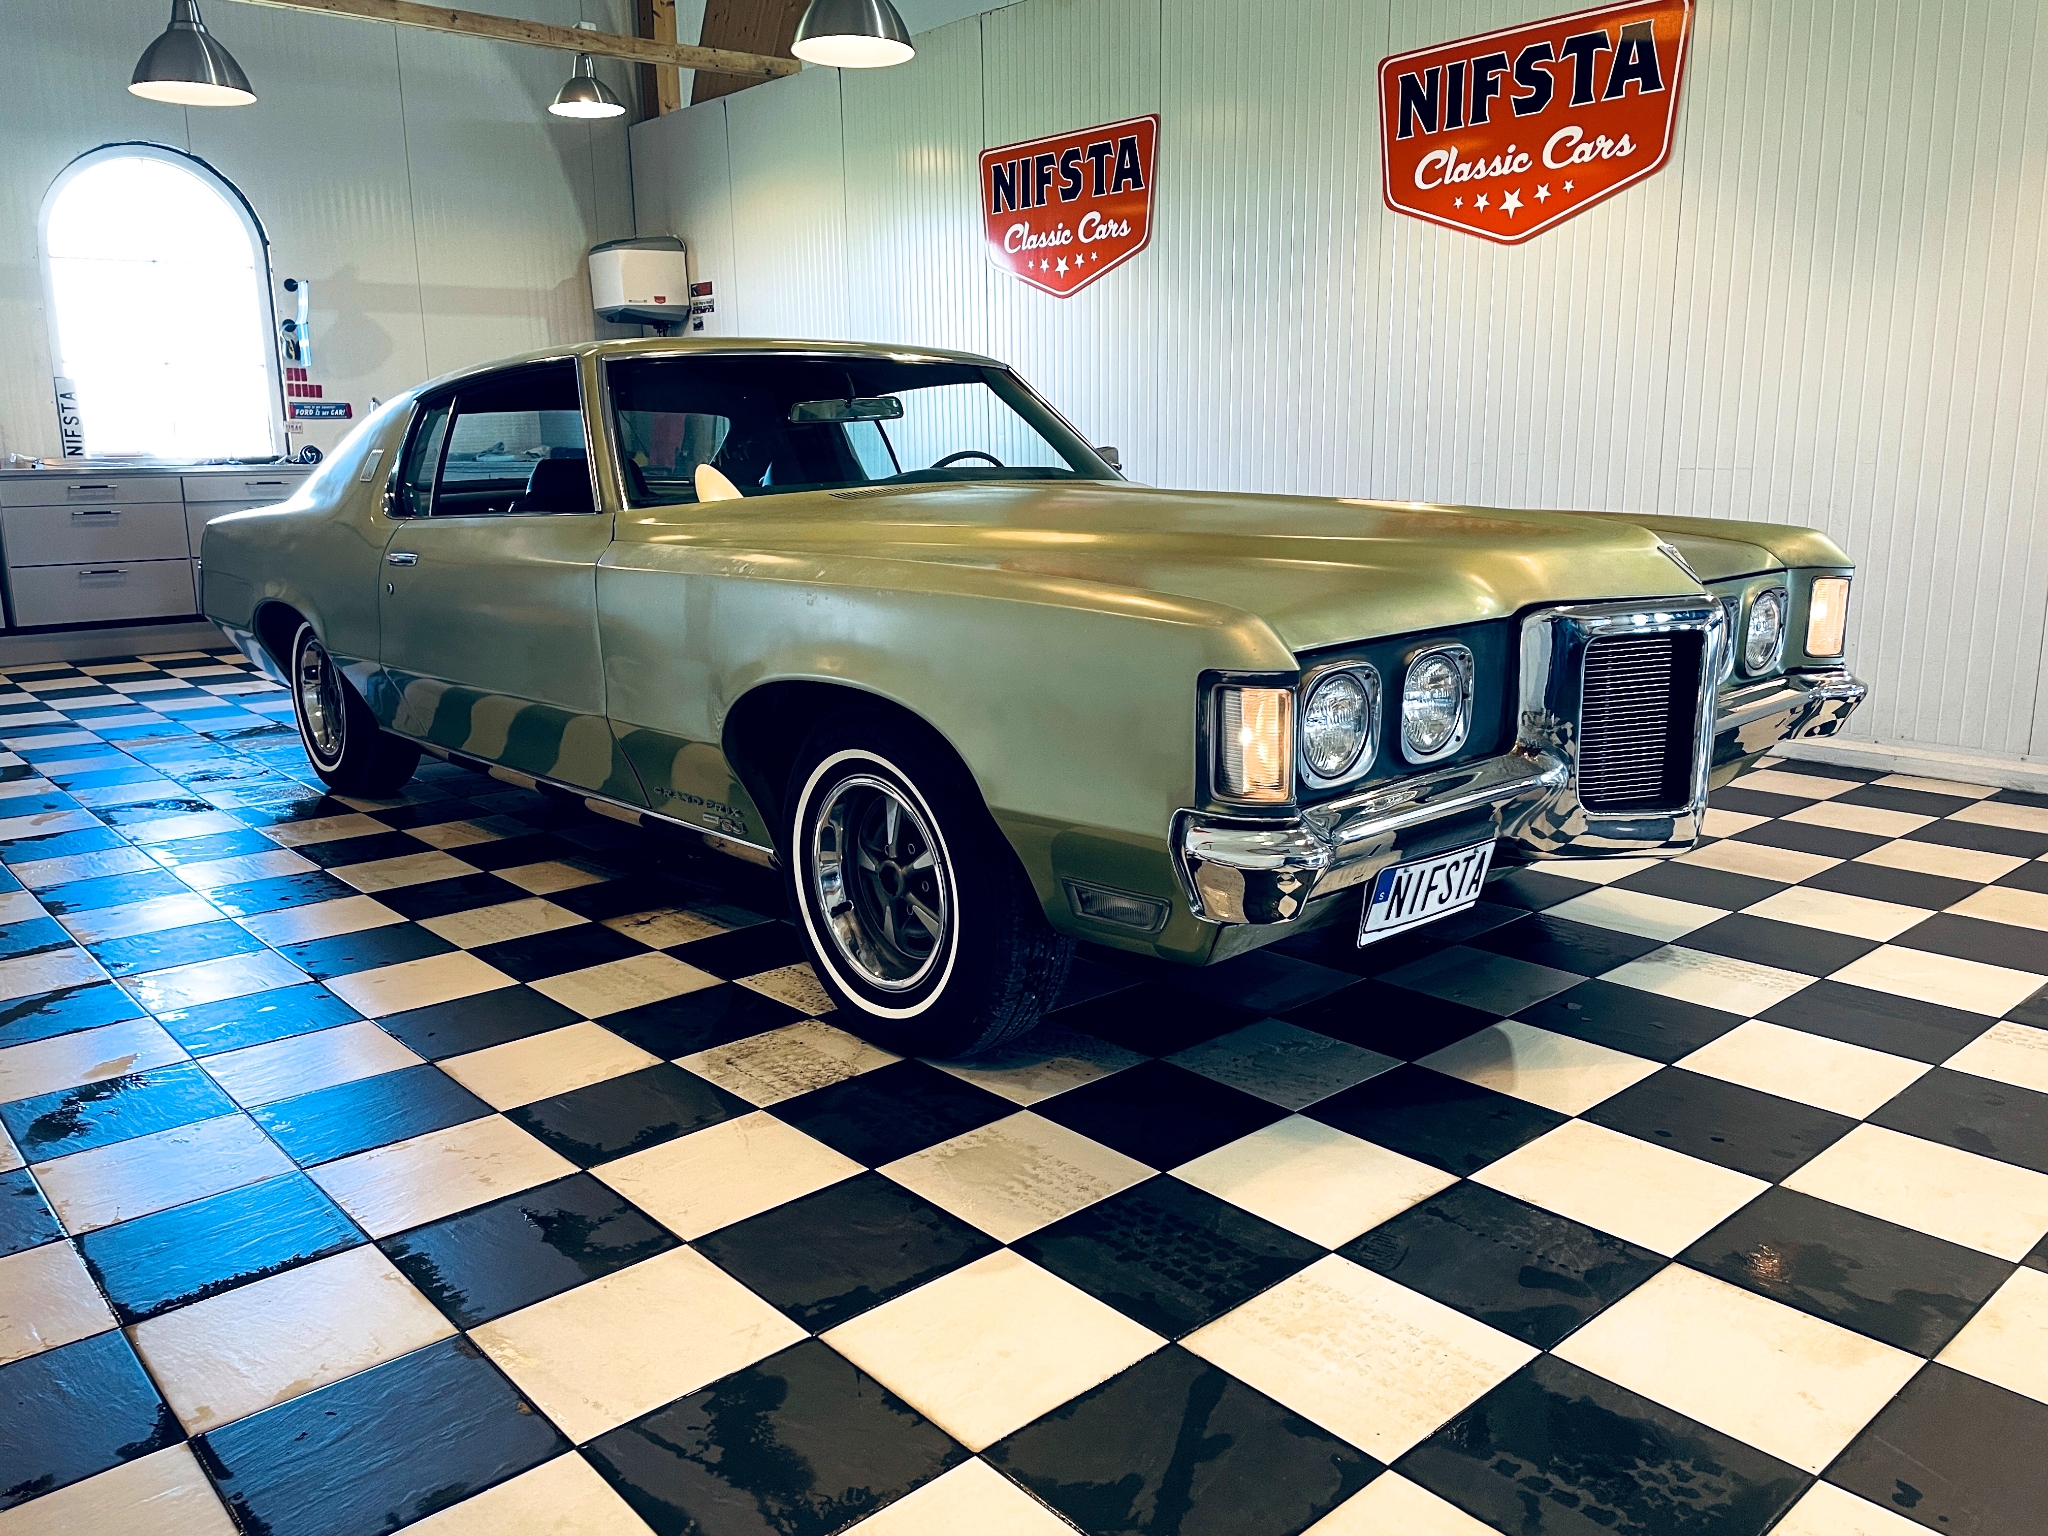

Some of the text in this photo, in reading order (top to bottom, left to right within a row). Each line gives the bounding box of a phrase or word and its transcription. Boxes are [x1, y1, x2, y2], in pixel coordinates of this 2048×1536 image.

[1396, 19, 1665, 140] NIFSTA
[991, 135, 1145, 215] NIFSTA
[1414, 125, 1636, 190] Classic Cars
[1004, 210, 1131, 254] Classic Cars
[60, 392, 84, 456] NIFSTA
[295, 408, 314, 416] FORD
[706, 800, 743, 818] PRIX
[1378, 850, 1487, 921] S NIFSTA
